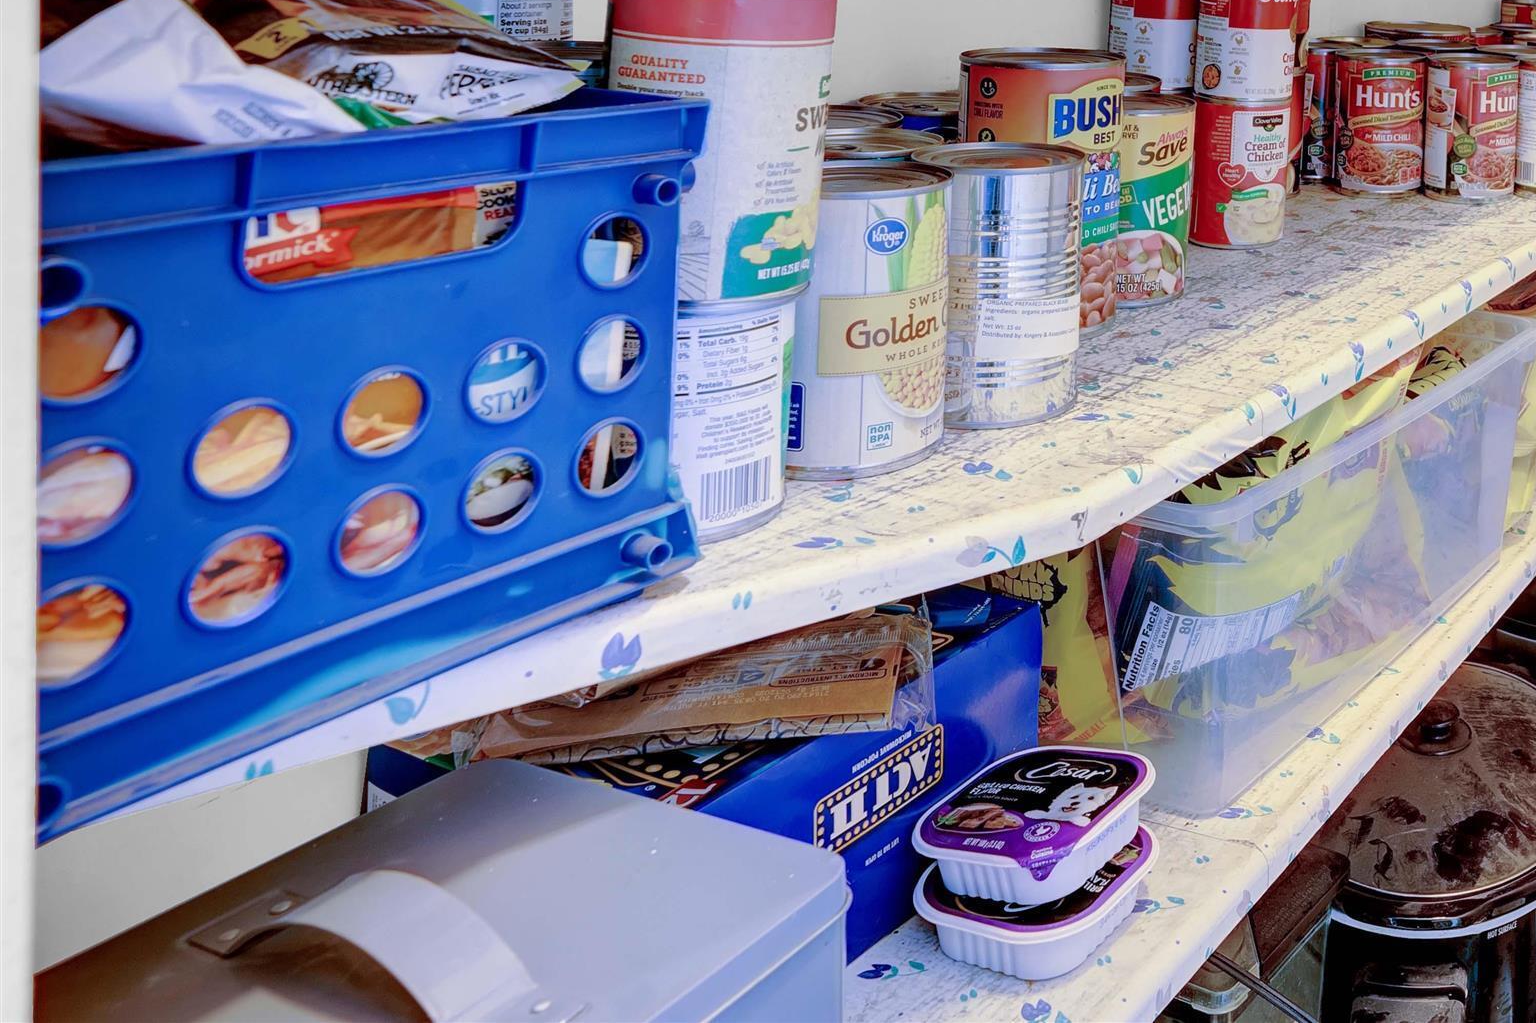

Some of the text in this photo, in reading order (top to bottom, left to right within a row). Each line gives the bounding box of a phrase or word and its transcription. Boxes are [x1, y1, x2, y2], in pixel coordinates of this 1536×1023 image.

[501, 2, 552, 11] About servings
[500, 11, 512, 19] per
[500, 18, 547, 28] Serving size
[515, 27, 529, 35] cup
[631, 54, 689, 69] QUALITY
[618, 66, 706, 85] GUARANTEED
[1370, 69, 1411, 77] PREMIUM
[617, 82, 636, 91] Double
[637, 85, 655, 94] your
[656, 88, 683, 97] money
[1356, 83, 1421, 110] Hunt's
[1094, 131, 1115, 144] BEST
[1157, 128, 1189, 144] Always
[1254, 133, 1281, 142] Healthy
[1372, 133, 1411, 142] MILD CHILI
[1245, 138, 1286, 151] Cream of
[1138, 136, 1188, 167] Save
[1247, 151, 1283, 162] Chicken
[872, 226, 905, 248] Kroger
[1116, 275, 1131, 283] NET
[1116, 284, 1126, 292] 15
[1127, 283, 1139, 292] OZ
[845, 313, 939, 350] Golden
[718, 338, 736, 346] Carb.
[885, 345, 928, 363] WHOLE
[697, 382, 723, 390] Protein
[870, 424, 891, 433] non
[869, 432, 890, 443] BPA
[1178, 617, 1194, 635] 80
[1125, 605, 1160, 690] Nutrition Facts
[873, 742, 932, 813] ACT
[1027, 762, 1111, 781] Cesar
[1008, 783, 1046, 794] CHICKEN
[1487, 921, 1518, 940] HOT SURFACE
